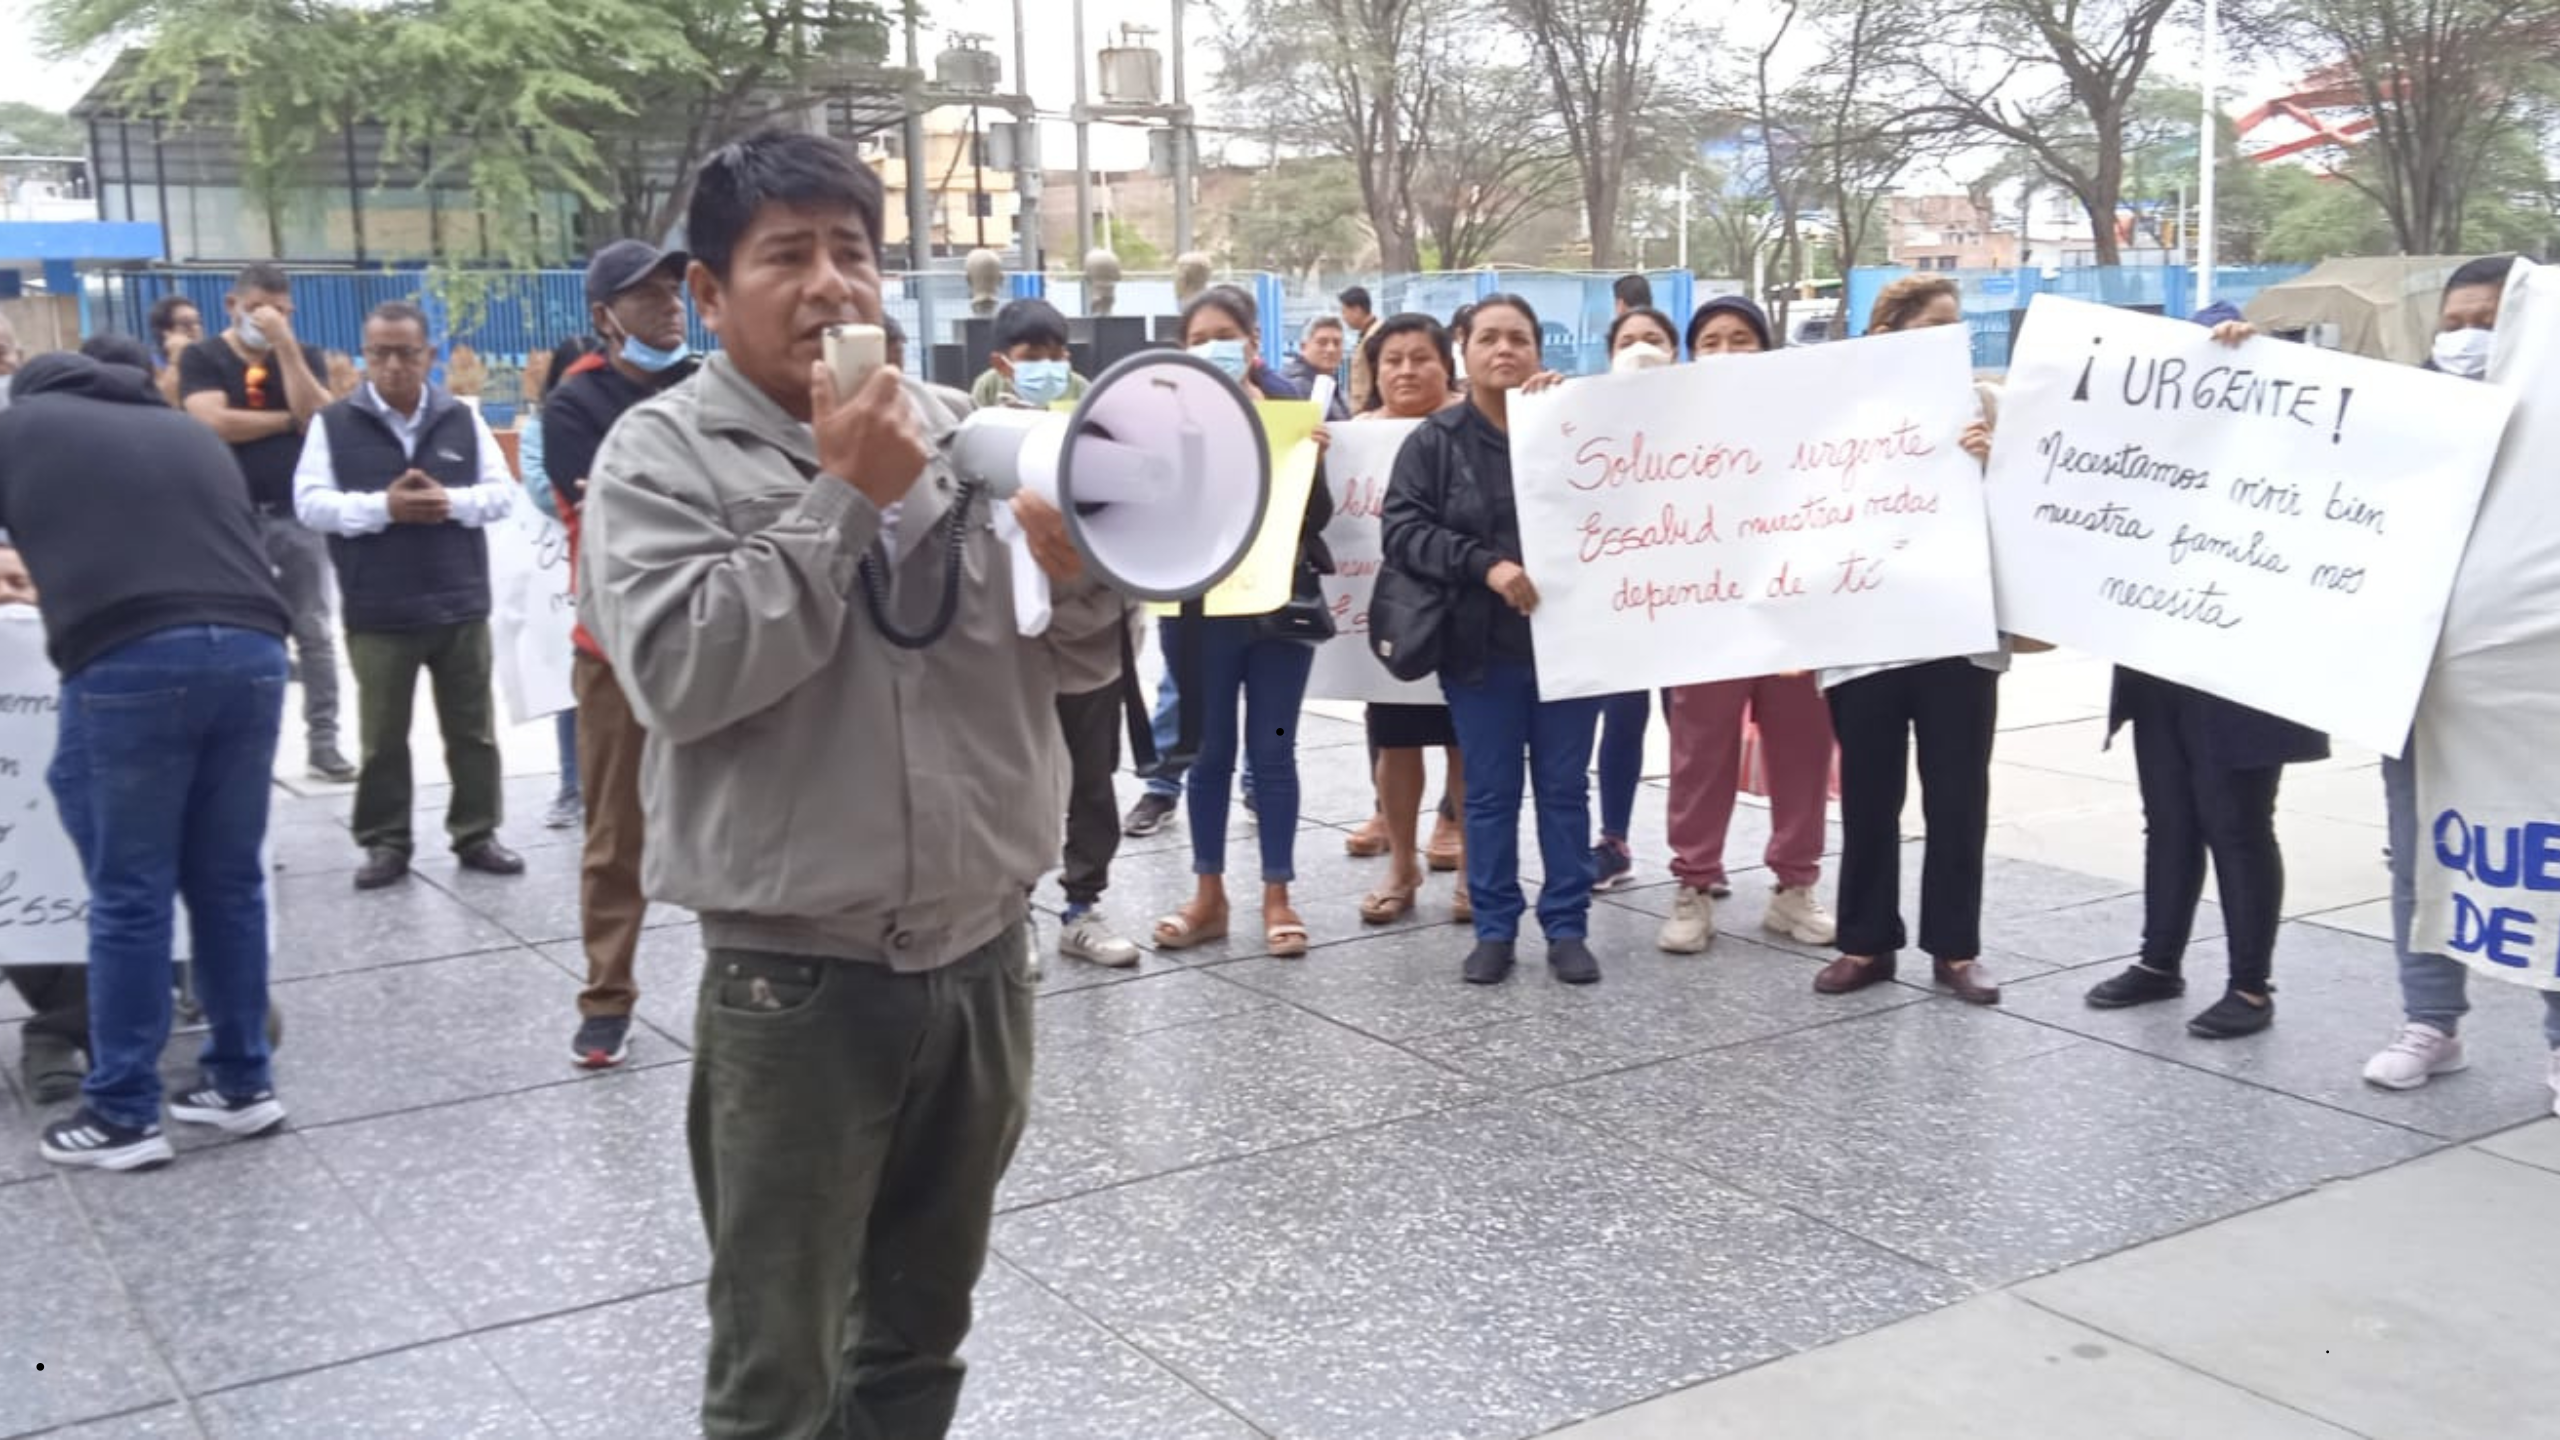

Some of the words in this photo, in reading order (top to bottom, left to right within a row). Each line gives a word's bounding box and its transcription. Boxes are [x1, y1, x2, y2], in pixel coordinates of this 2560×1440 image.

[1789, 417, 1937, 492] urgente
[2038, 430, 2209, 490] Necesitamos
[2324, 481, 2385, 535] bien
[2034, 501, 2154, 541] nuestra
[2169, 523, 2290, 574] familia
[2310, 563, 2366, 594] nos
[1613, 568, 1744, 622] depende
[1766, 562, 1806, 597] de
[2100, 576, 2243, 629] necesita
[2447, 893, 2538, 969] DE
